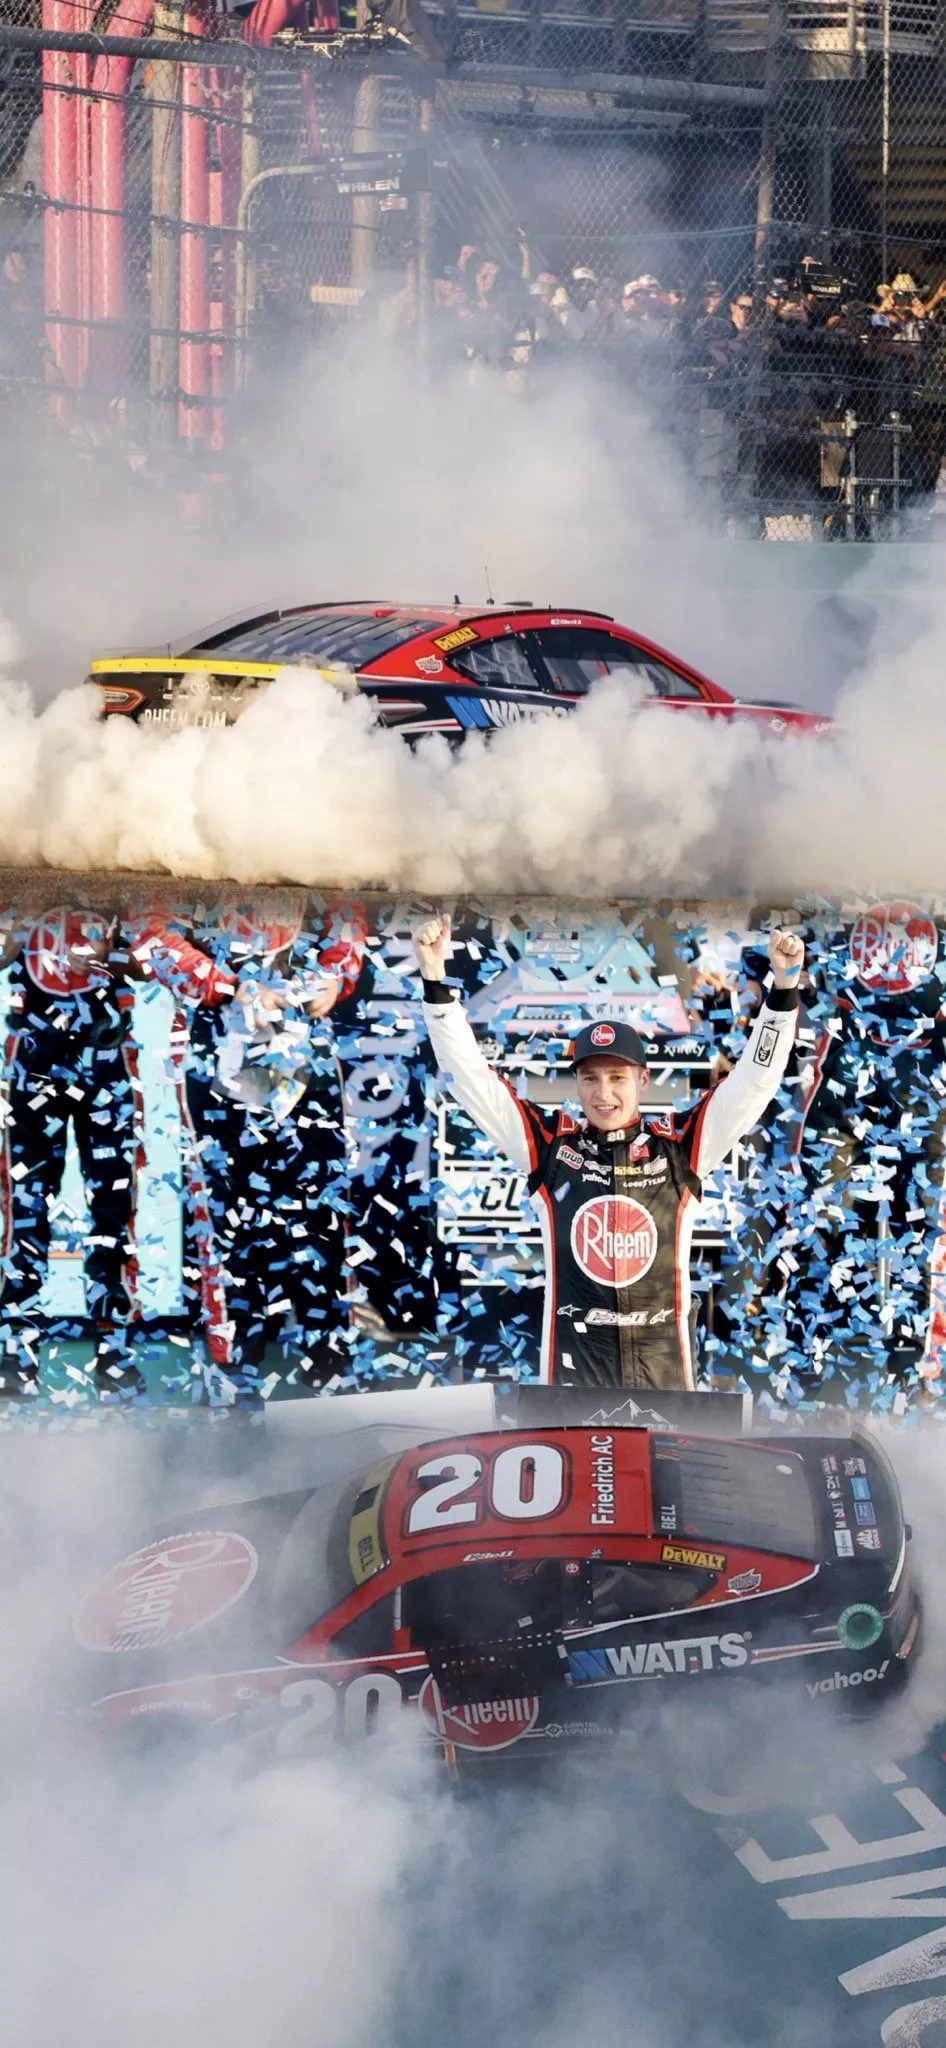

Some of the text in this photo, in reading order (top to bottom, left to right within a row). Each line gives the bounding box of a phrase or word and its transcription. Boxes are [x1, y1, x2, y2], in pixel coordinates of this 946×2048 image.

[606, 1129, 626, 1142] 20
[583, 1201, 650, 1270] Rheem
[408, 1444, 563, 1534] 20
[591, 1435, 615, 1524] Friedrich AC
[661, 1504, 676, 1530] BELL
[358, 1535, 375, 1574] BELL
[604, 1632, 747, 1676] WATTS
[806, 1660, 889, 1701] yahoo!
[277, 1673, 403, 1749] 20
